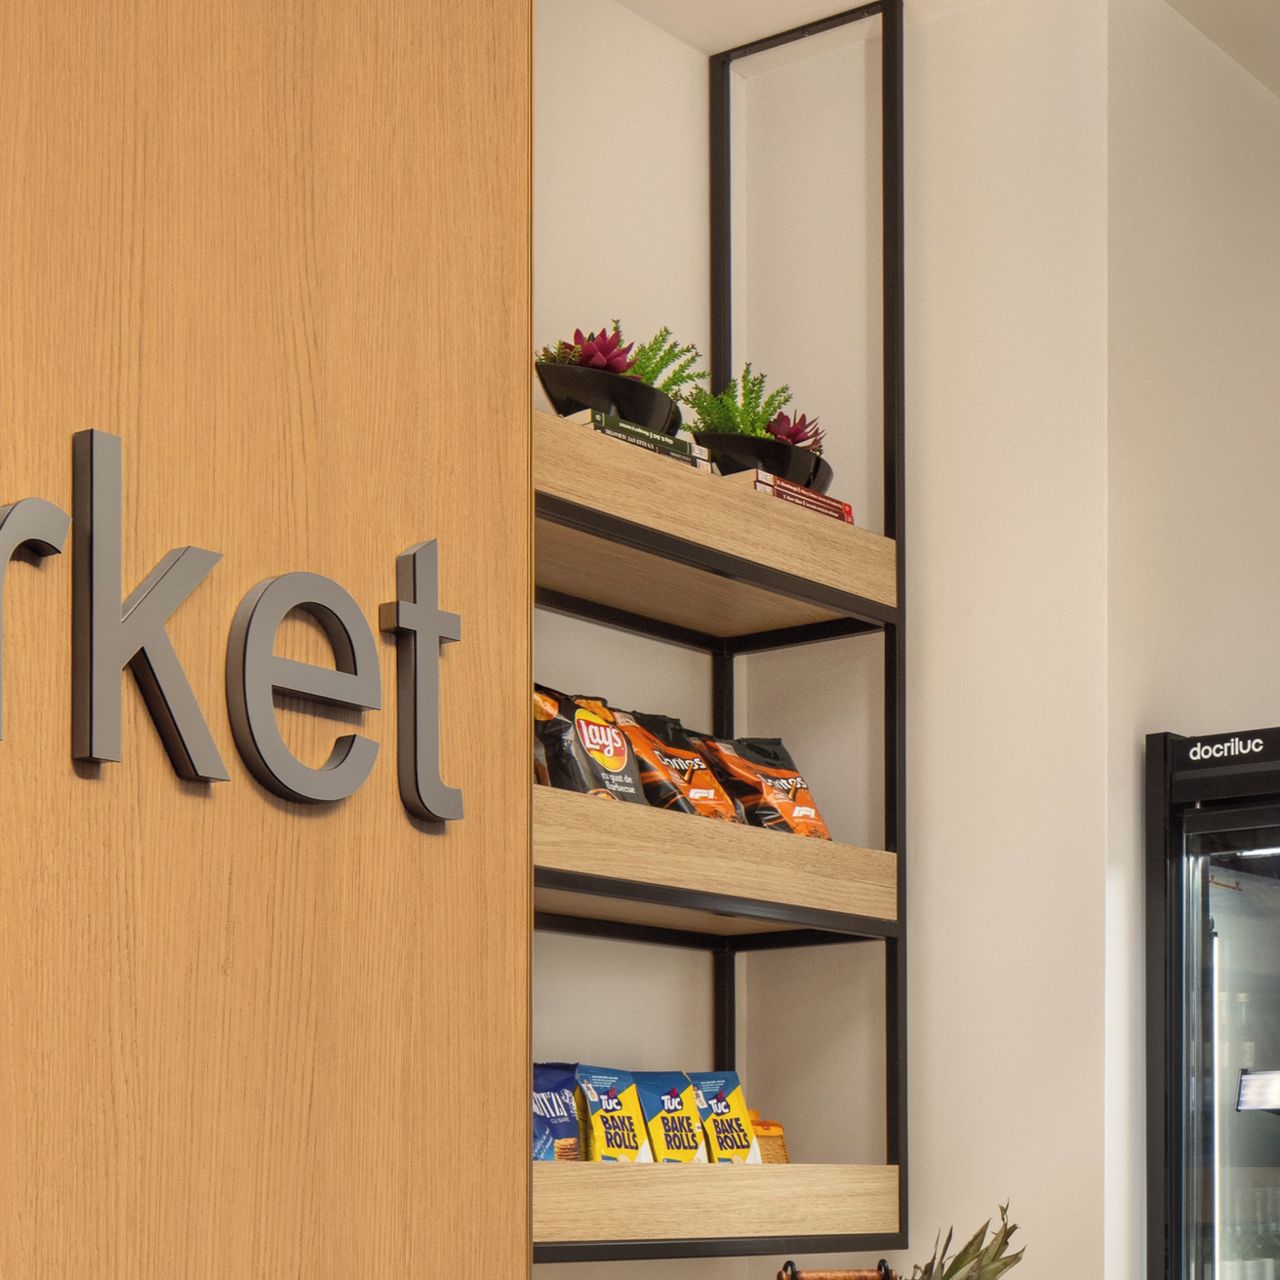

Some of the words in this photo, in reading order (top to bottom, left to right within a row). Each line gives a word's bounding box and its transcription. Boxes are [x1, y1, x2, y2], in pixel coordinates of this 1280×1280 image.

[578, 718, 622, 757] Lay's
[1188, 737, 1265, 761] docriluc
[600, 1115, 634, 1132] BAKE
[661, 1116, 693, 1133] BAKE
[712, 1118, 744, 1134] BAKE
[605, 1131, 638, 1150] ROLLS
[664, 1133, 698, 1150] ROLLS
[716, 1134, 750, 1150] ROLLS
